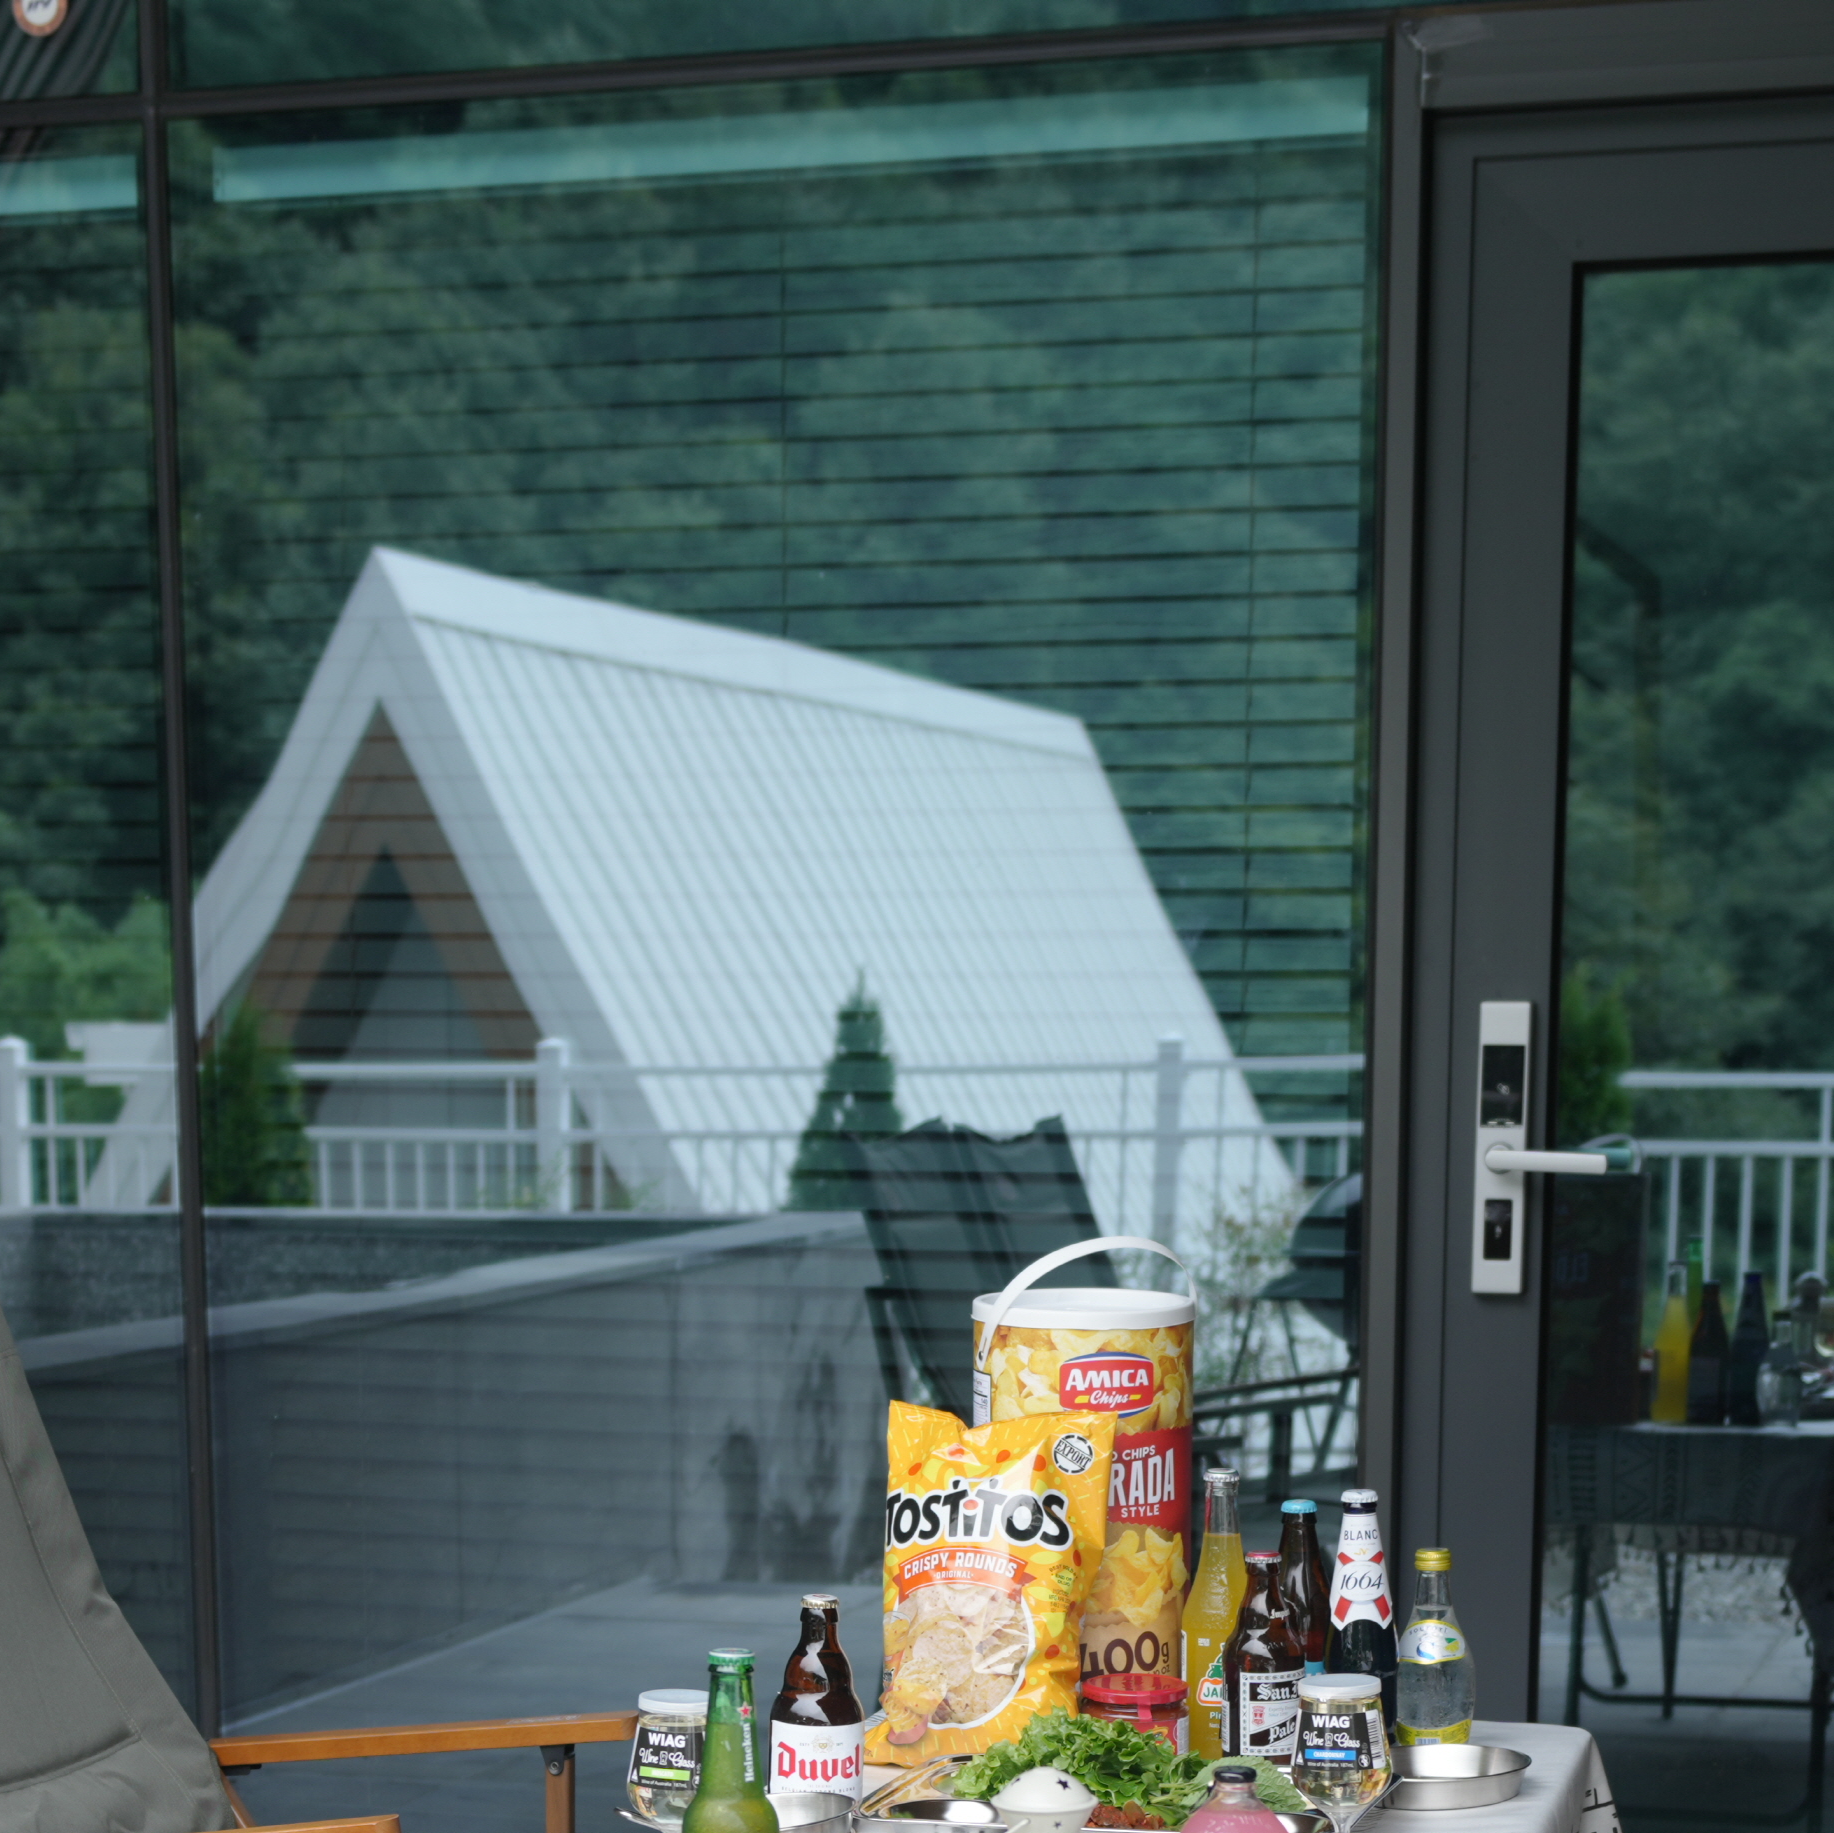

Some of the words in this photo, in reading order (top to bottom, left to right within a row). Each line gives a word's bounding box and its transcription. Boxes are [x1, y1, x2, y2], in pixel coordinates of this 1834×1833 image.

[1065, 1368, 1149, 1391] AMICA
[1090, 1390, 1129, 1408] Chips
[1055, 1438, 1092, 1470] EXPORT
[1122, 1444, 1155, 1461] CHIPS
[1121, 1504, 1160, 1518] STYLE
[1344, 1529, 1378, 1541] BLANC
[903, 1552, 950, 1580] CRISPY
[955, 1552, 1018, 1578] ROUNDS
[936, 1571, 972, 1580] ORIGINAL
[1340, 1570, 1384, 1590] 1664
[1257, 1683, 1290, 1700] San
[1311, 1715, 1350, 1728] WIAG
[648, 1732, 685, 1748] WIAG
[1268, 1720, 1295, 1744] Pale
[1303, 1731, 1324, 1746] Wine
[1334, 1732, 1360, 1748] Glass
[639, 1748, 659, 1764] Wine
[668, 1752, 695, 1768] Glass
[742, 1723, 754, 1782] Heineken
[777, 1741, 860, 1783] Duvel
